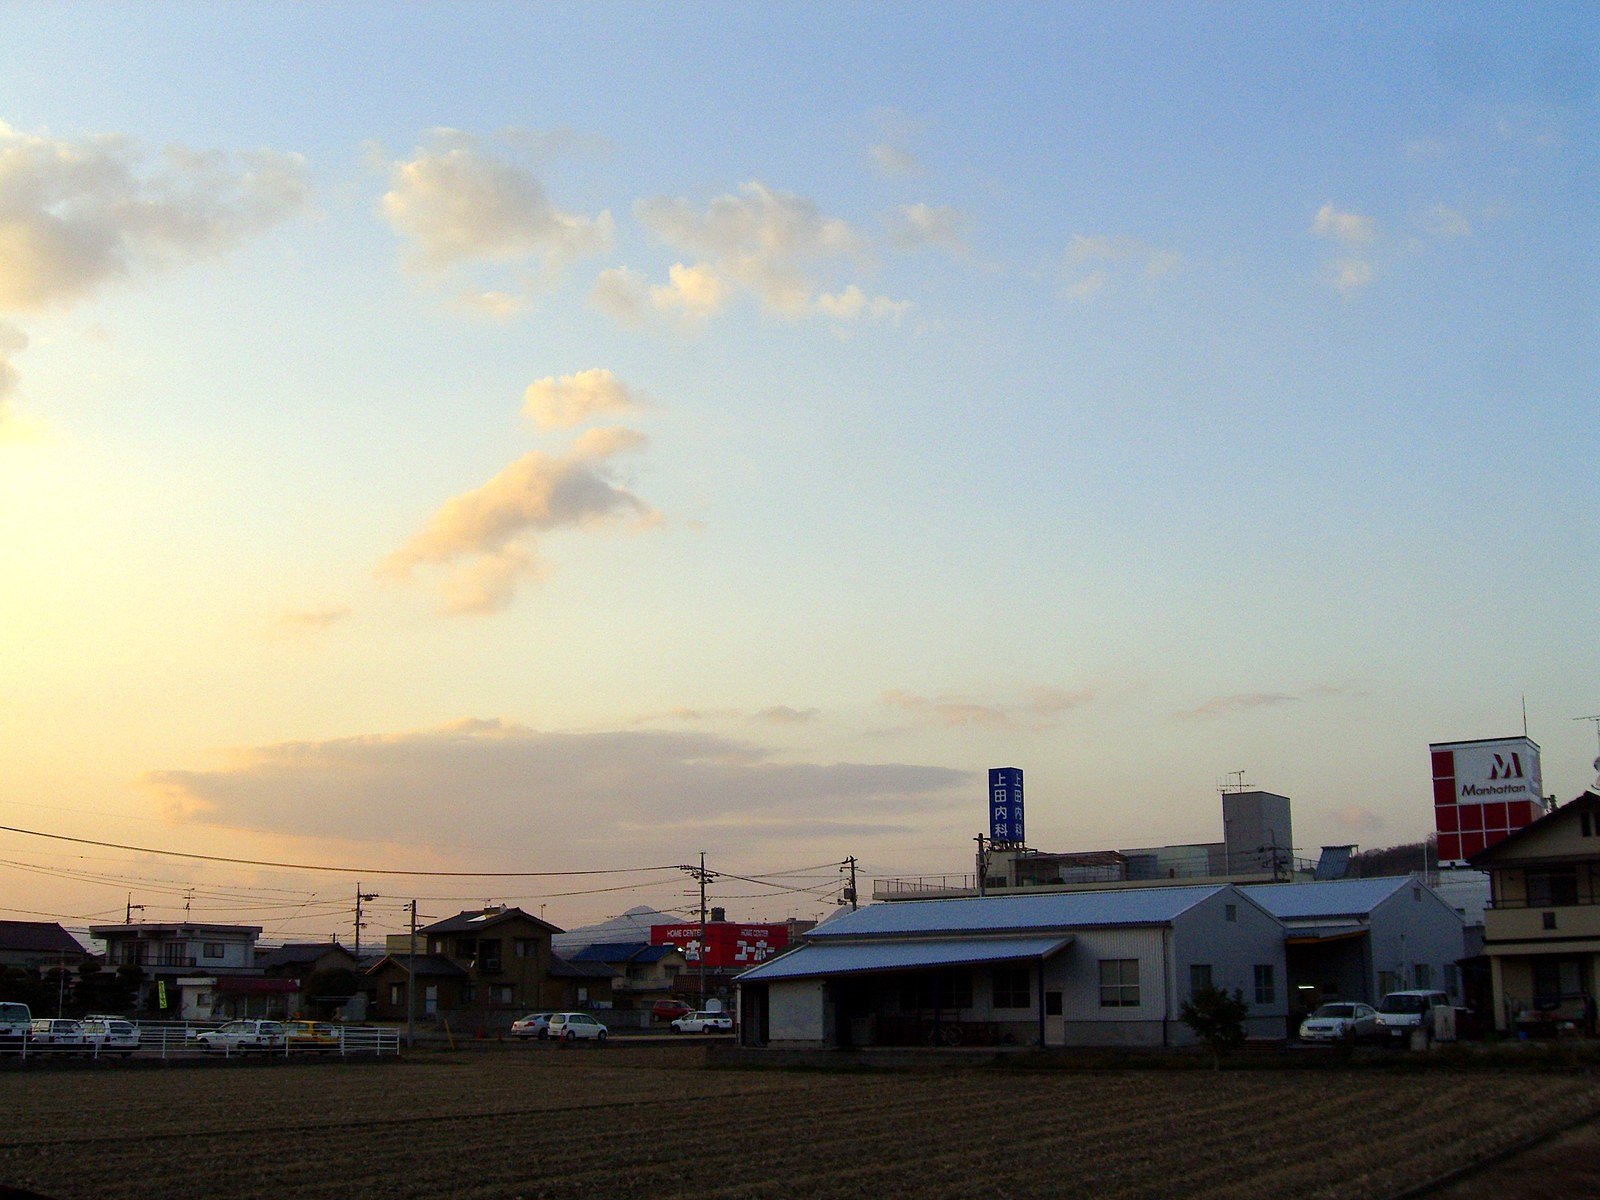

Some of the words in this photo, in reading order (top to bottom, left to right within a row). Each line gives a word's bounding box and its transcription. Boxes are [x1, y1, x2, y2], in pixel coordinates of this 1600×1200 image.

[1461, 784, 1526, 796] Manhattan
[994, 772, 1008, 837] 上田内科
[667, 929, 682, 938] HOME
[682, 929, 703, 938] CENTE
